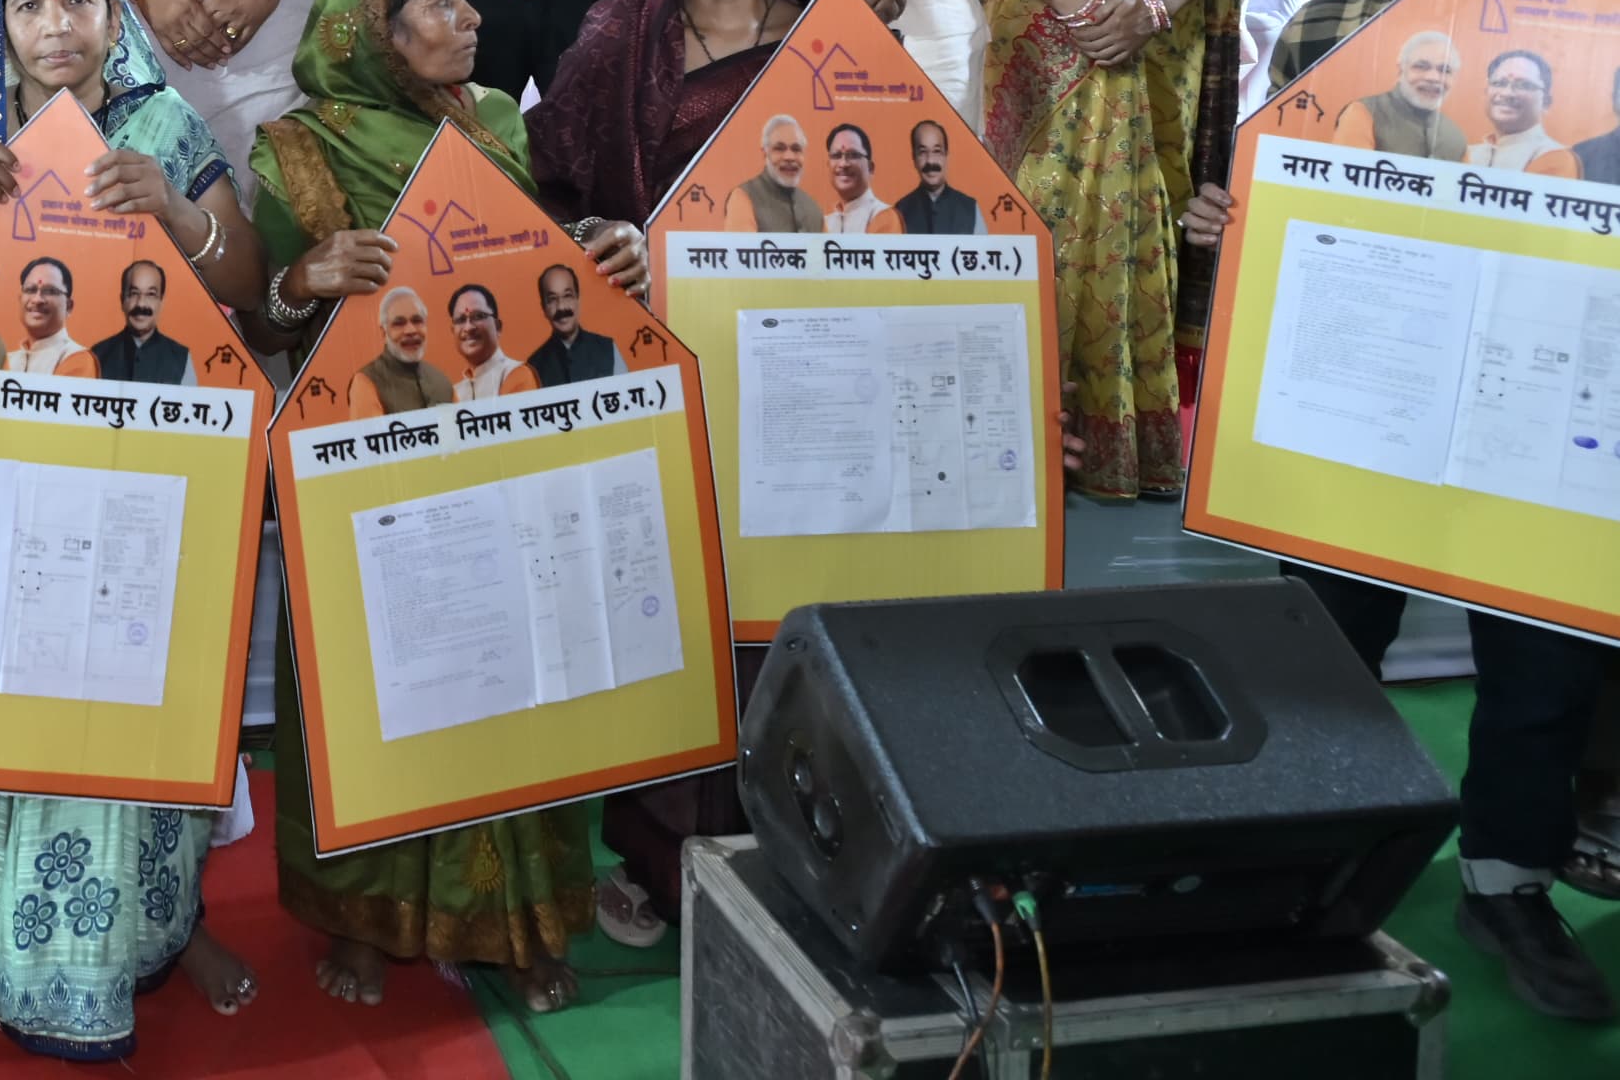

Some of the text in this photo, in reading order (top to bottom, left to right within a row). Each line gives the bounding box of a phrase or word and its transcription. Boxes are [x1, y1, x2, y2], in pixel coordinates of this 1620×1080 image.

[1282, 155, 1332, 182] नगर
[1344, 160, 1434, 196] पालिक
[1458, 172, 1532, 211] निगम
[127, 220, 145, 239] 2.0
[687, 240, 1022, 280] नगर पालिक निगम रायपुर (छ.ग.)
[1, 379, 61, 413] निगम
[71, 394, 137, 429] रायपुर
[150, 396, 233, 432] (छ.ग.)
[312, 380, 666, 464] नगर पालिक निगम रायपुर (छ.ग.)
